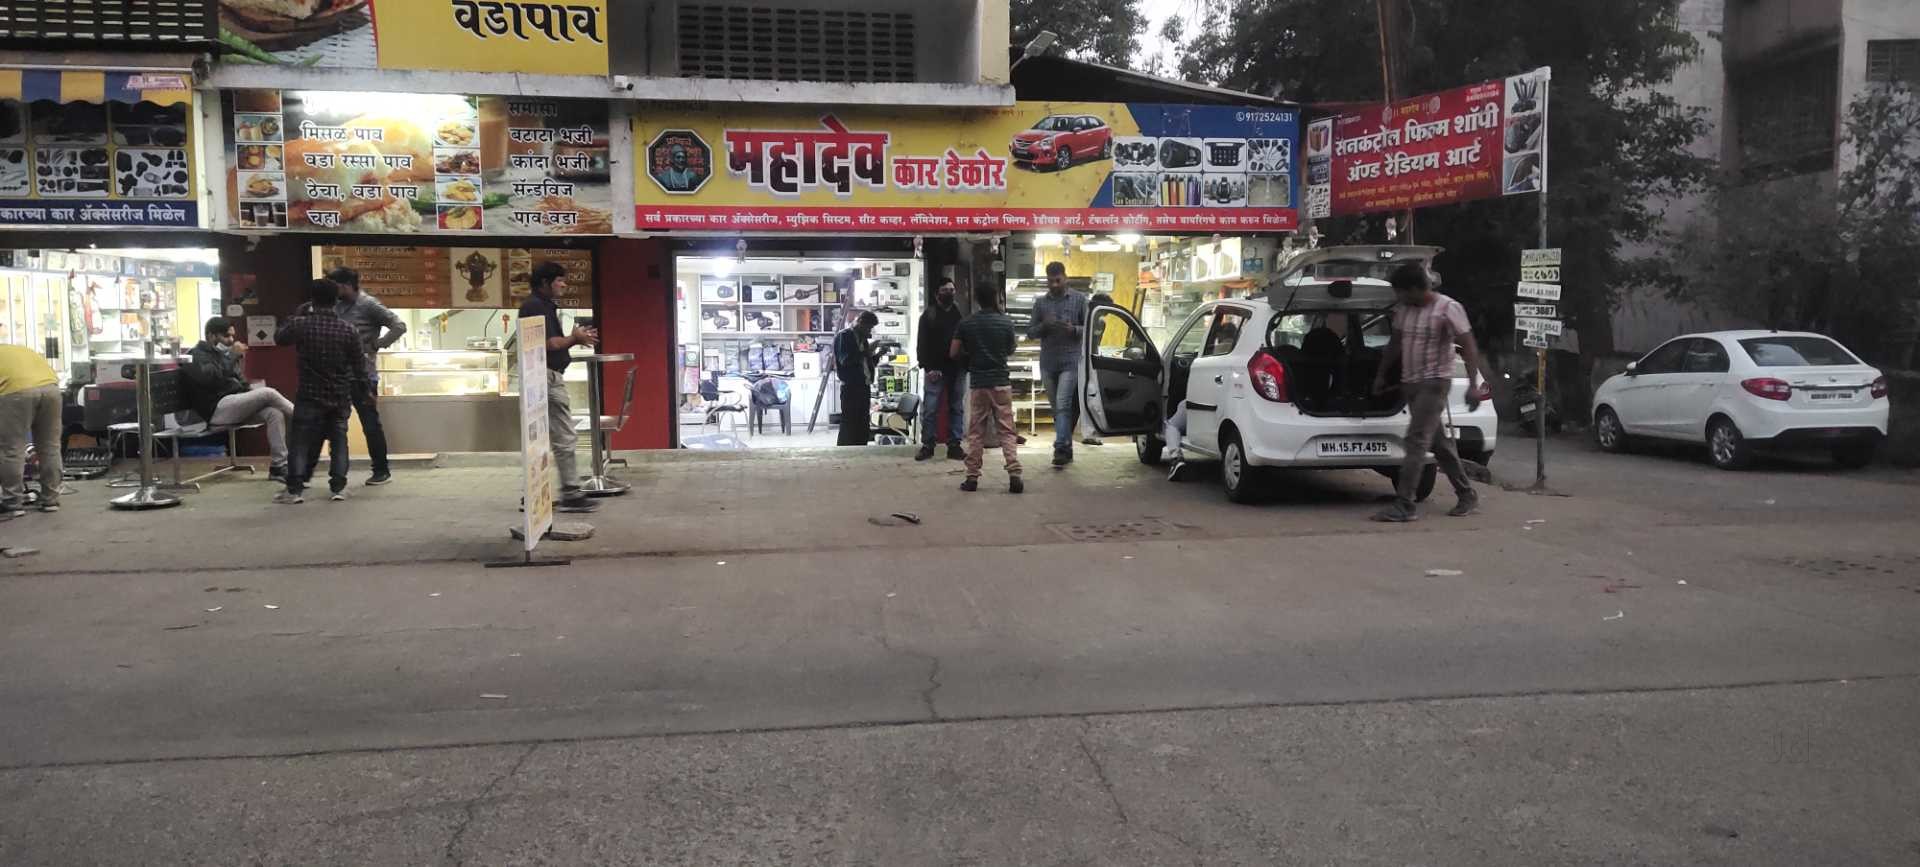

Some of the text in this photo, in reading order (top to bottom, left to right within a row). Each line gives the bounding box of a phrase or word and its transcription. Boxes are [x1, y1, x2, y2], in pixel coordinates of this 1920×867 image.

[451, 0, 603, 43] वडापाव
[1245, 112, 1293, 122] 9172524131
[1405, 118, 1449, 144] फिल्म
[1454, 102, 1499, 133] शॉपी
[299, 120, 383, 141] मिसळ पाव
[509, 124, 593, 144] बटाटा भजी
[304, 152, 413, 169] वडा रस्सा पाव
[511, 149, 589, 171] कांदा भजी
[725, 114, 889, 195] महादेव
[893, 156, 940, 188] कार
[944, 147, 1007, 188] डेकोर
[1444, 137, 1482, 167] आर्ट
[307, 179, 418, 201] ठेचा, वडा पाव
[50, 207, 75, 222] कार
[147, 204, 186, 222] मिळेल
[307, 210, 340, 225] चहा
[514, 210, 578, 225] पाव वडा
[709, 213, 727, 224] कार
[956, 215, 970, 225] सन
[1321, 442, 1388, 453] MH.15.FT.4575
